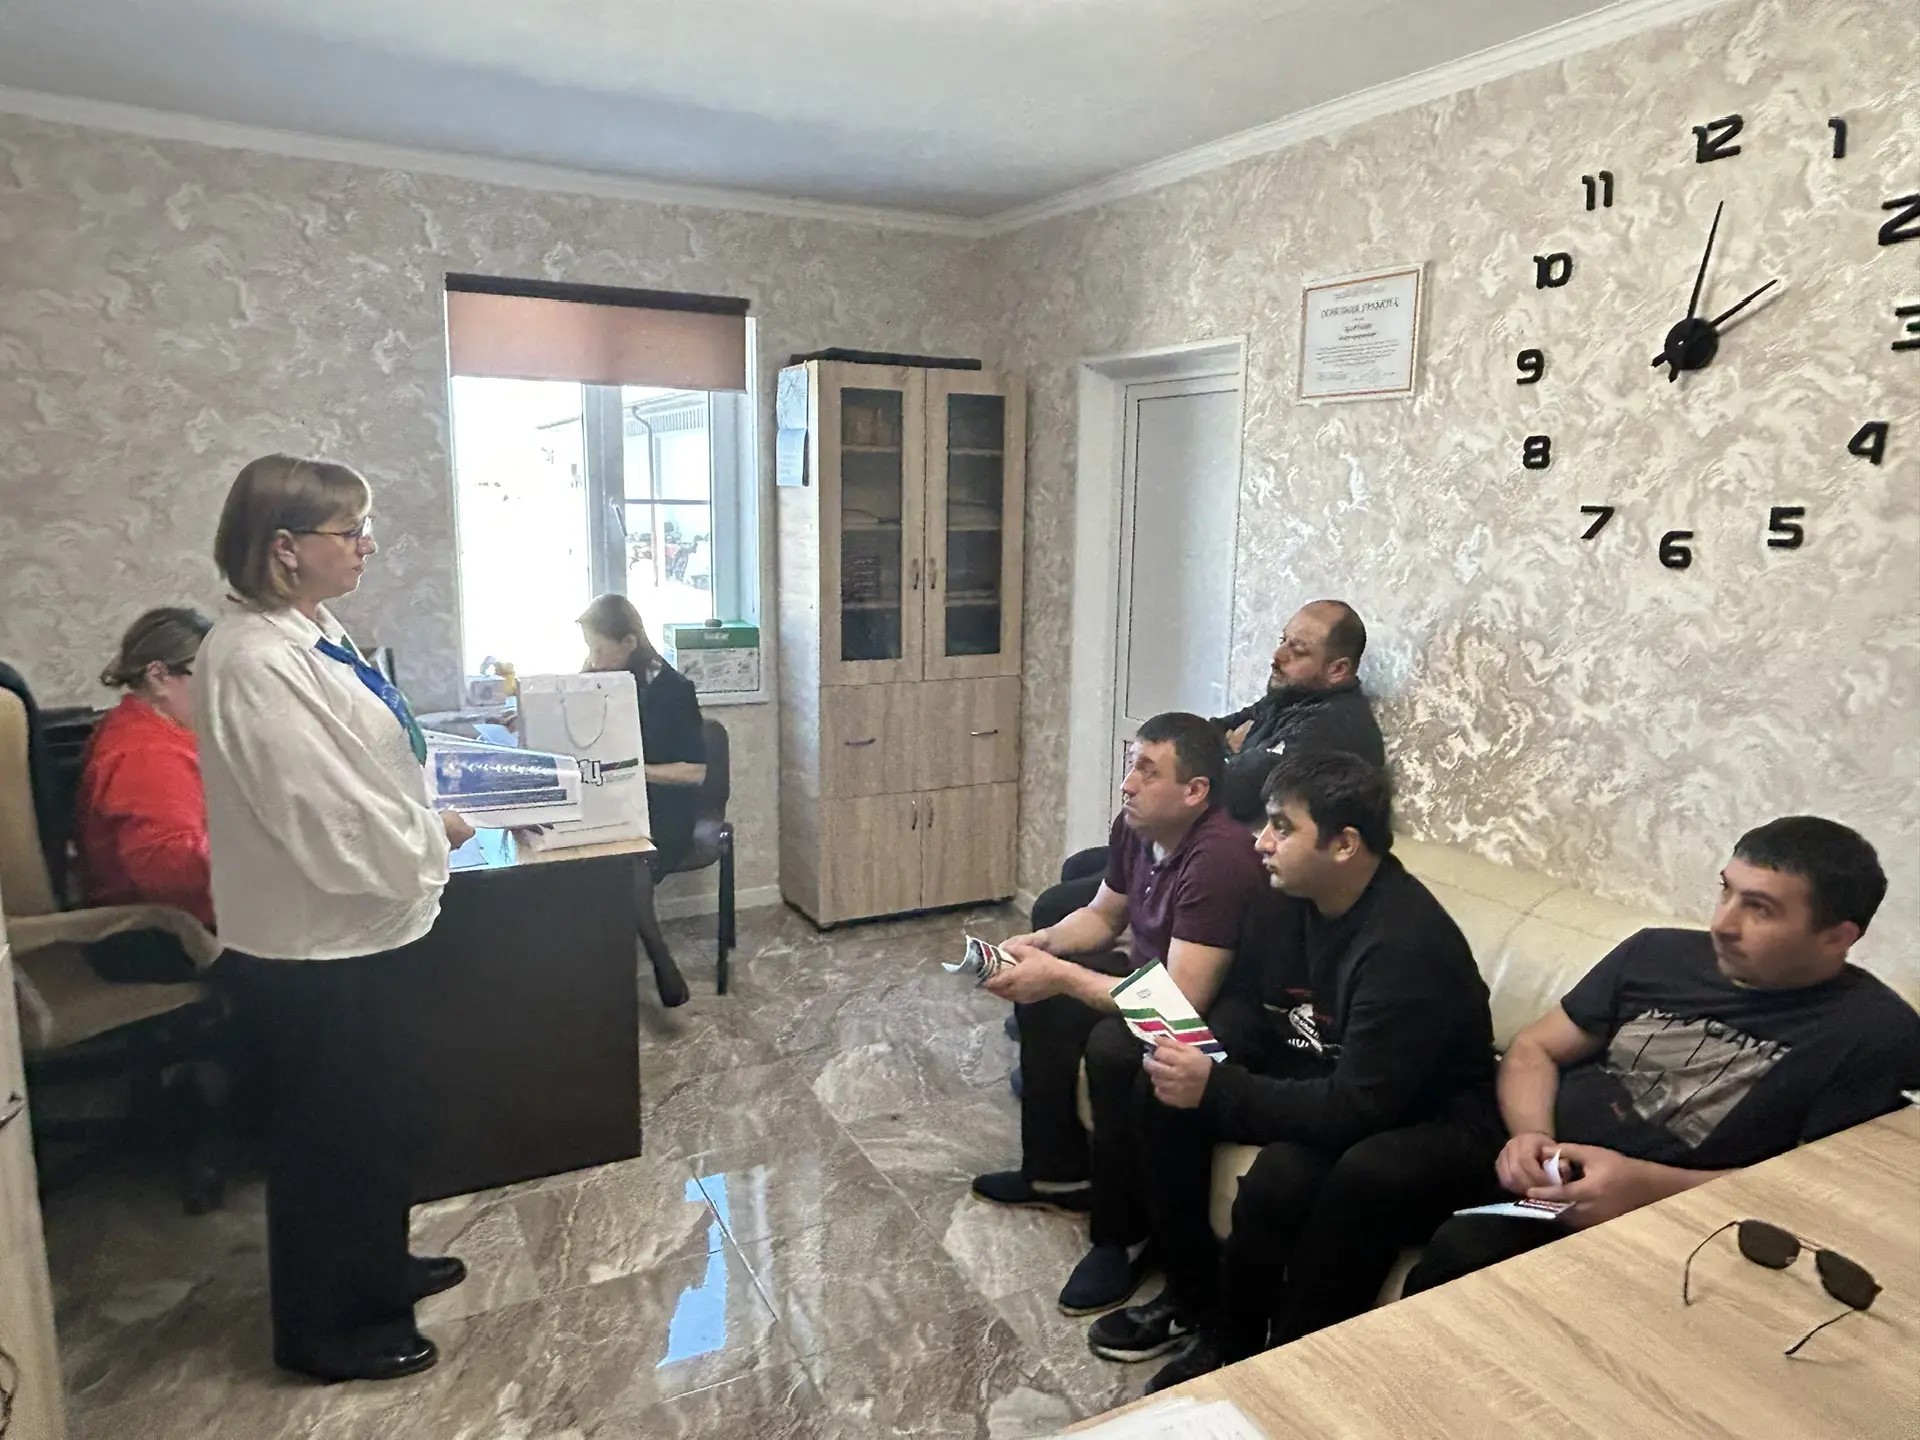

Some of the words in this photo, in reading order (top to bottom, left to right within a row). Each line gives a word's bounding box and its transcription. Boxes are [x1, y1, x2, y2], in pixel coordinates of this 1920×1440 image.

[1692, 114, 1743, 164] 12
[1827, 118, 1847, 159] 1
[1582, 171, 1614, 211] 11
[1878, 194, 1920, 246] 2
[1534, 252, 1573, 290] 10
[1516, 348, 1545, 386] 9
[1523, 435, 1552, 470] 8
[1847, 421, 1890, 466] 4
[1580, 506, 1616, 540] 7
[1767, 506, 1806, 550] 5
[1659, 530, 1694, 570] 6
